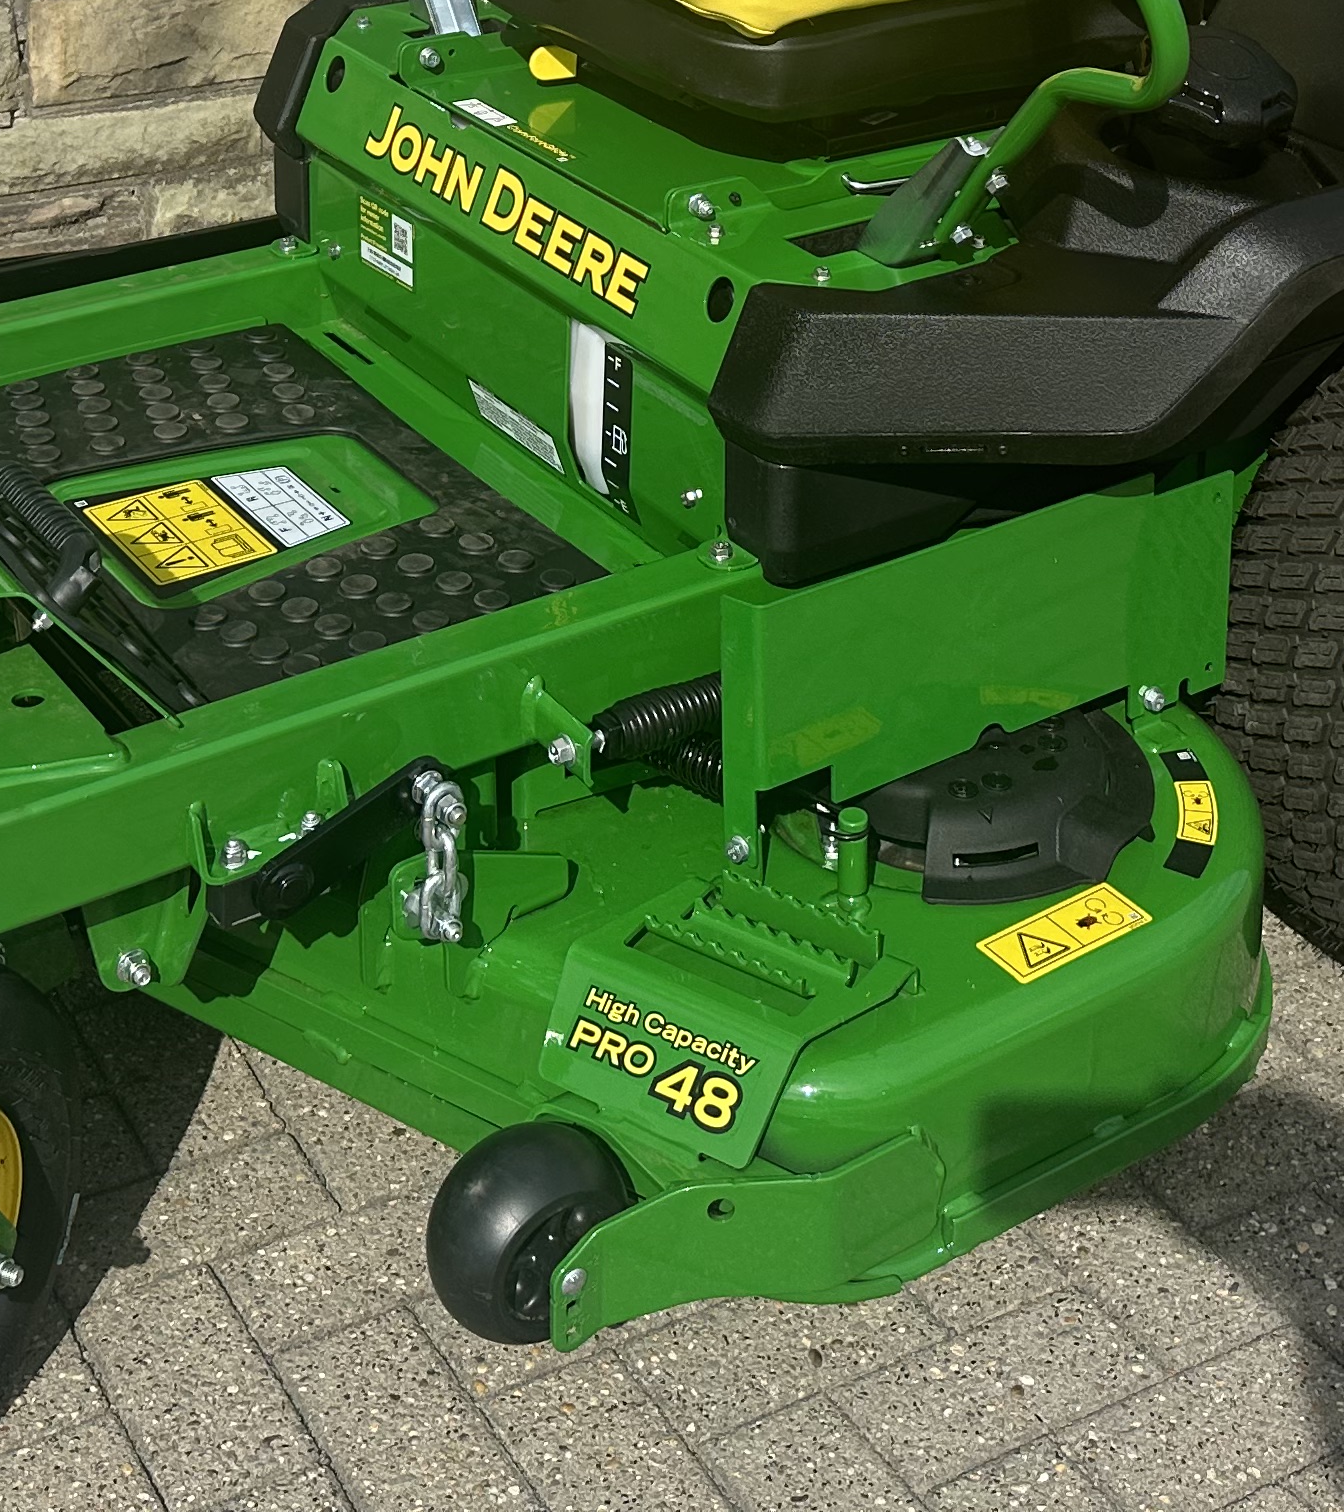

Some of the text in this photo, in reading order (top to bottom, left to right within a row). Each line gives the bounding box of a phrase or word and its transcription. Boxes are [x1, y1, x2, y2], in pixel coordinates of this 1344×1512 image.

[363, 104, 650, 316] JOHN DEERE
[614, 356, 622, 371] F
[568, 1018, 739, 1129] PRO 48
[584, 986, 757, 1076] High Capacity
